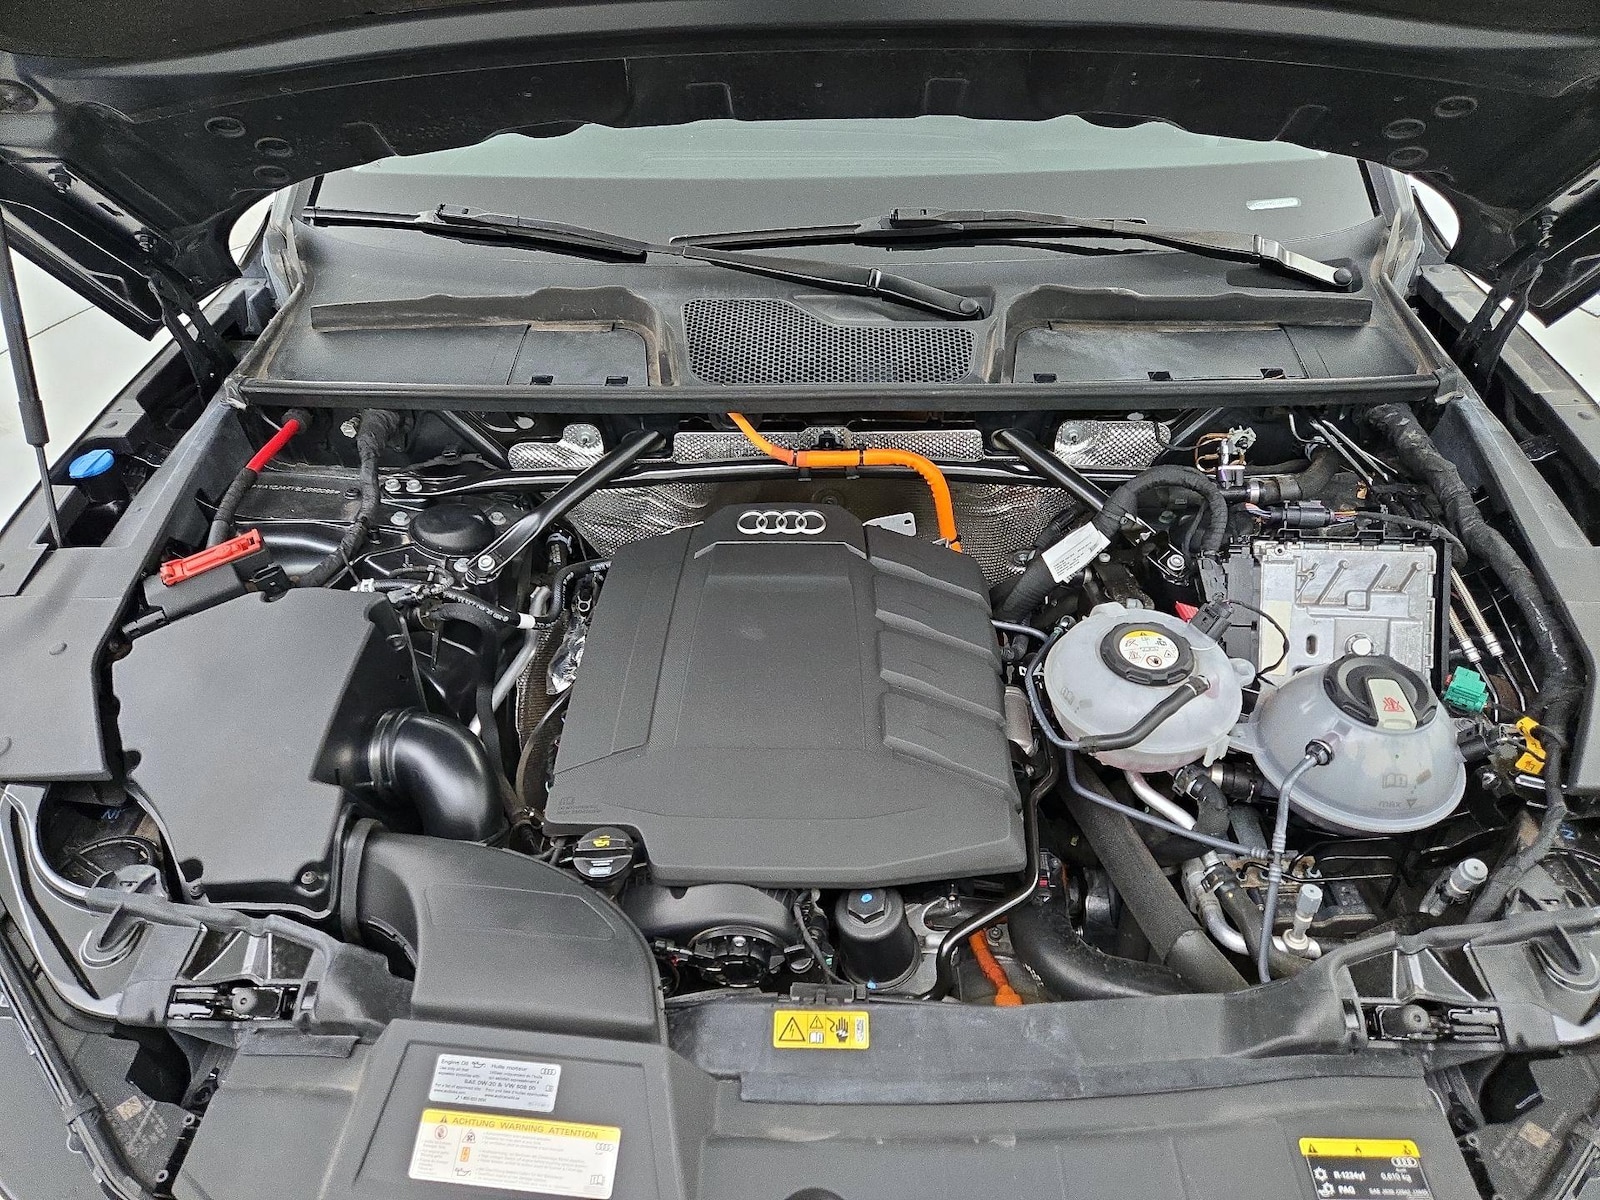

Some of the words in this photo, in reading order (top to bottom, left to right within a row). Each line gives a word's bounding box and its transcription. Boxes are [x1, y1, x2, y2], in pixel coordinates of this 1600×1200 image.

[441, 1058, 459, 1066] Engine
[452, 1118, 495, 1128] ACHTUNG
[500, 1122, 545, 1134] WARNING
[548, 1126, 599, 1139] ATTENTION
